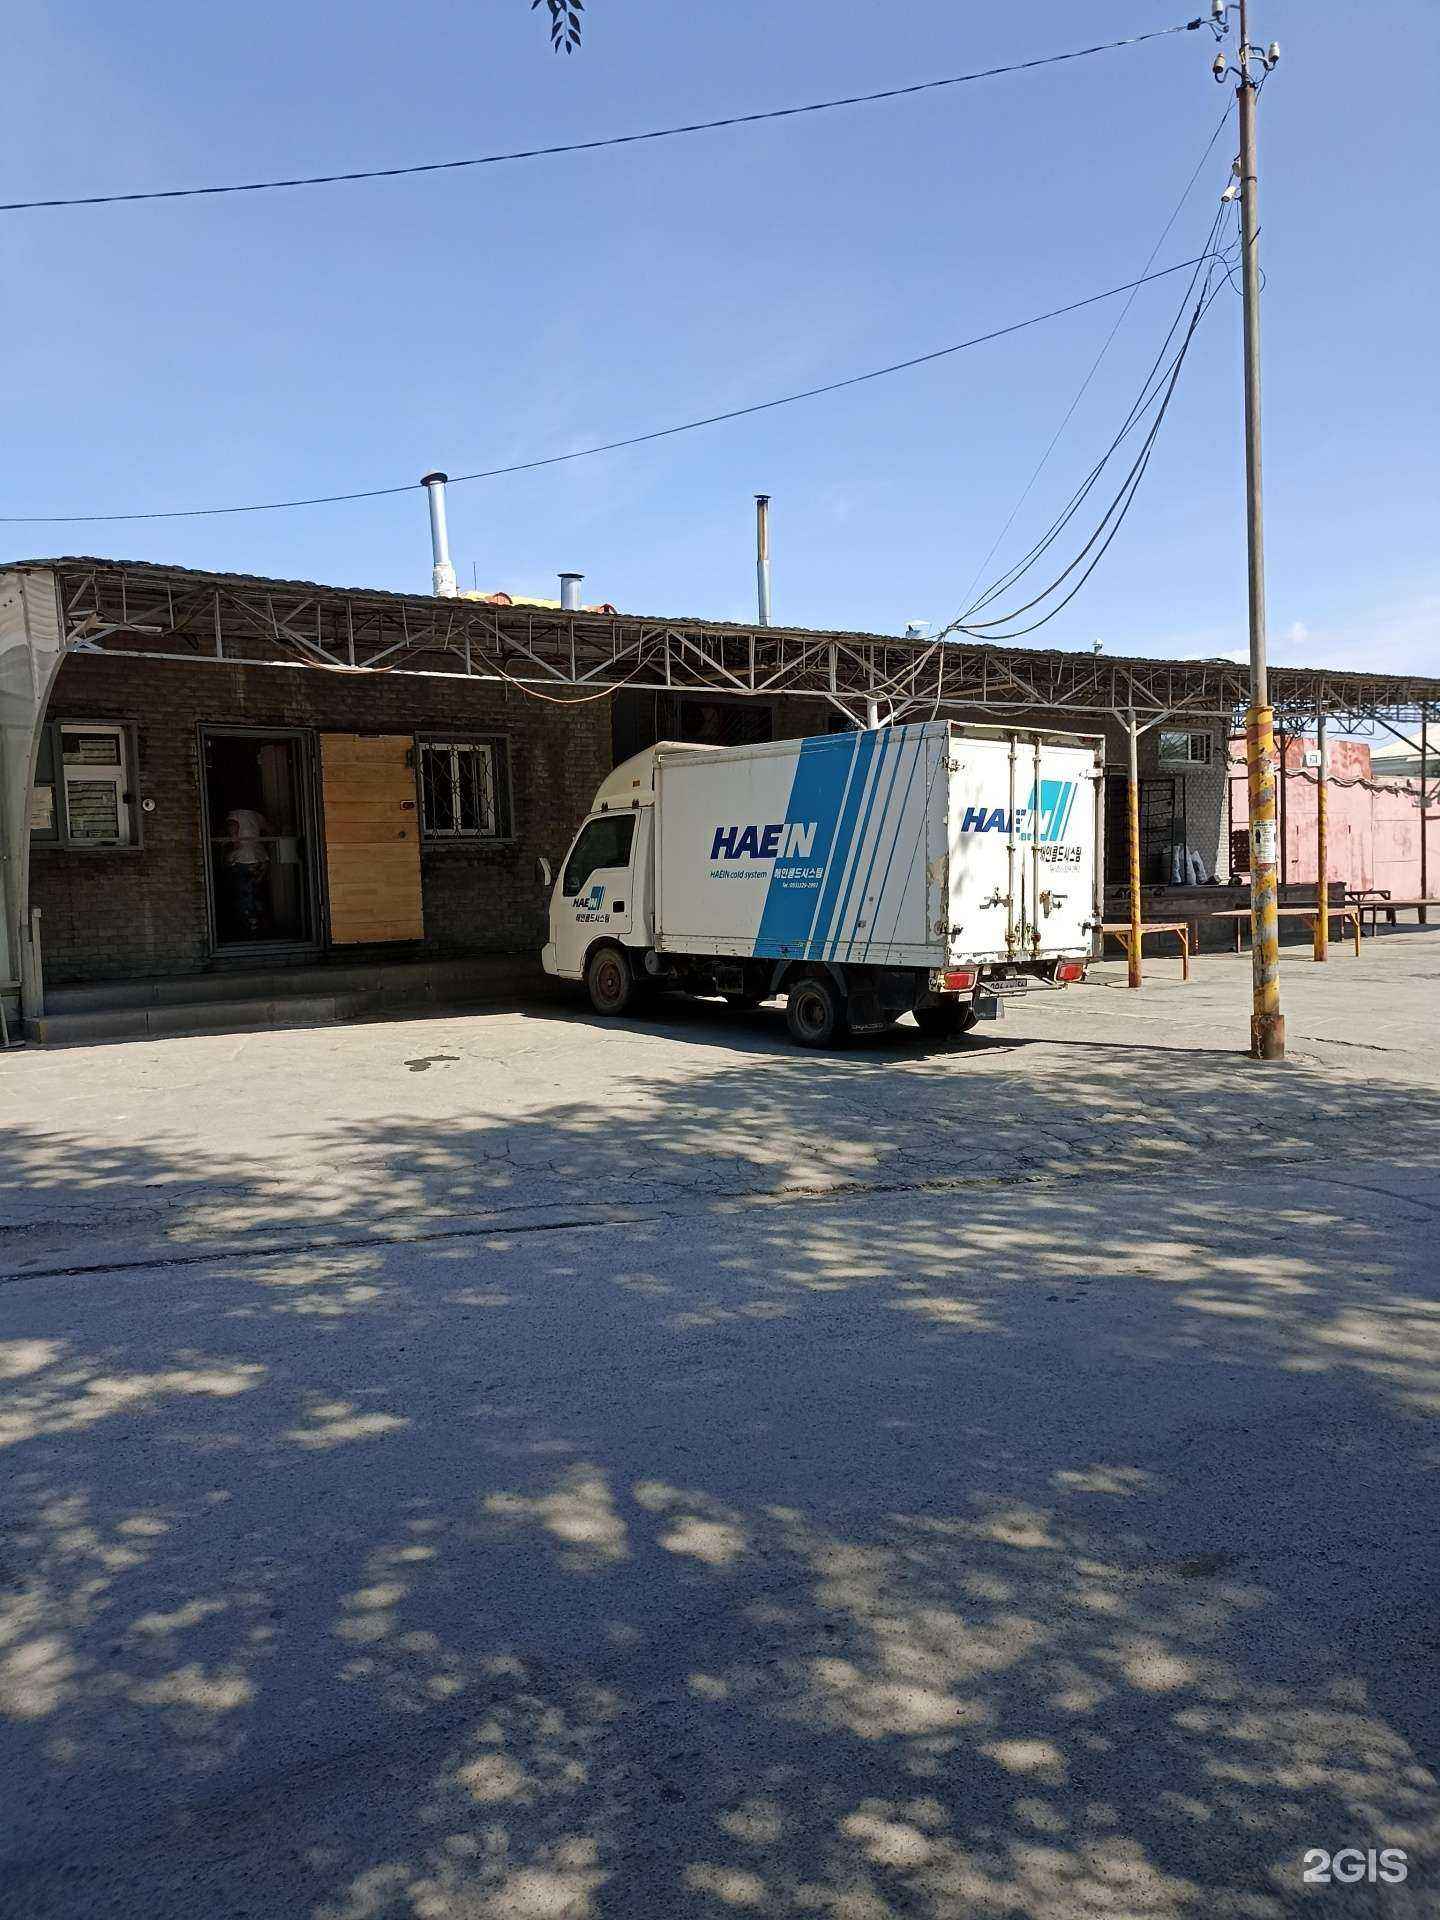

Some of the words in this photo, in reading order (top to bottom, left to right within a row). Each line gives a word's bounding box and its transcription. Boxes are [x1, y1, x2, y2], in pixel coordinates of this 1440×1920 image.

[710, 822, 818, 860] HAEIN
[711, 870, 730, 879] HAEIN
[730, 870, 745, 879] cold
[744, 870, 768, 881] system
